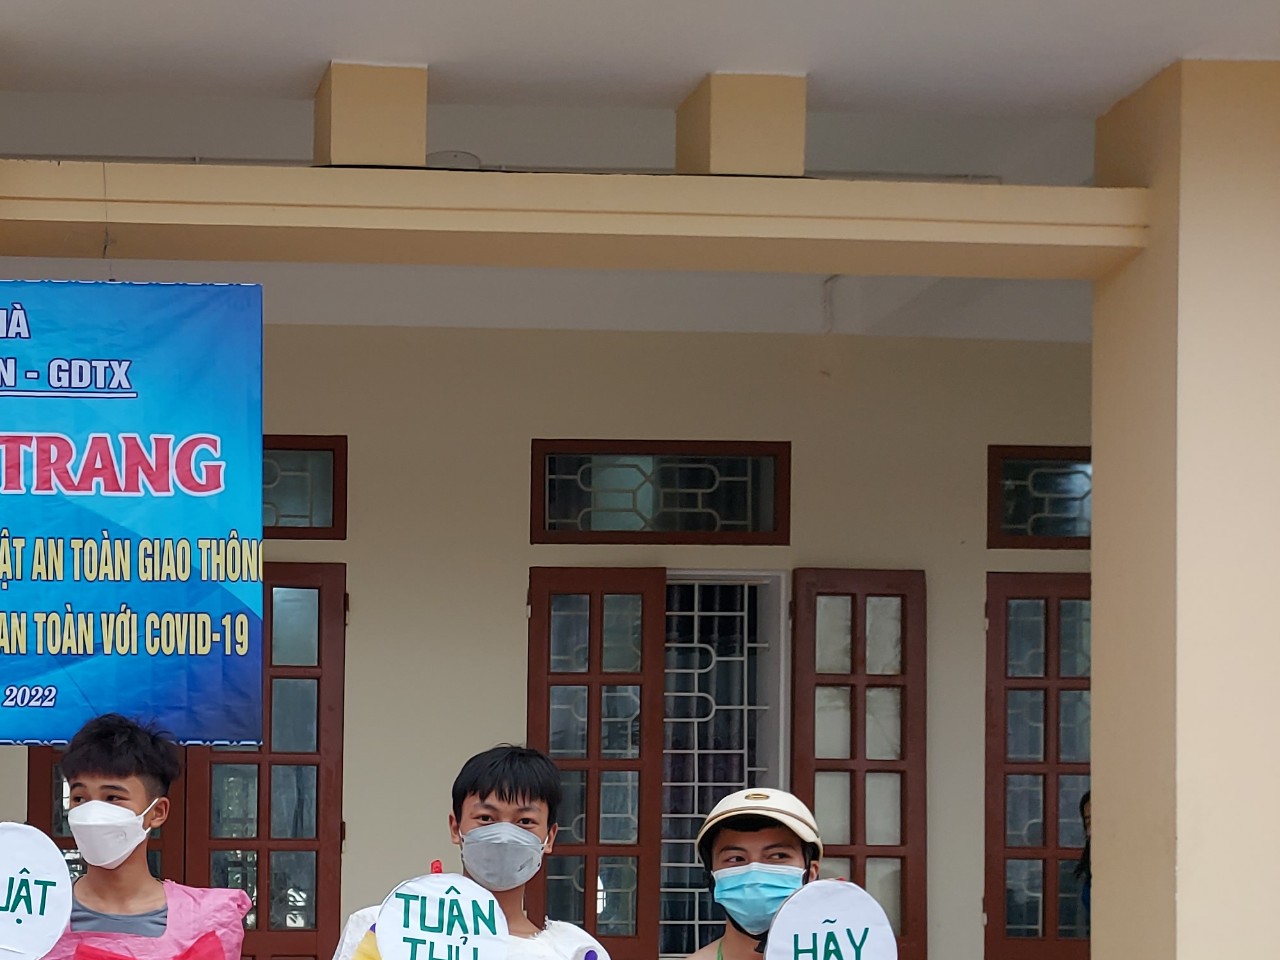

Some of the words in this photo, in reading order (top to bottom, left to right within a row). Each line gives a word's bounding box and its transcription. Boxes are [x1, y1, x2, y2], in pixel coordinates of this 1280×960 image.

[48, 360, 132, 389] GDTX
[31, 537, 64, 582] AN
[70, 530, 131, 582] TOÀN
[138, 537, 192, 582] GIAO
[34, 604, 94, 655] TOÀN
[100, 605, 138, 655] VỚI
[145, 612, 249, 656] COVID-19
[2, 686, 57, 708] 2022
[395, 885, 497, 936] TUÂN
